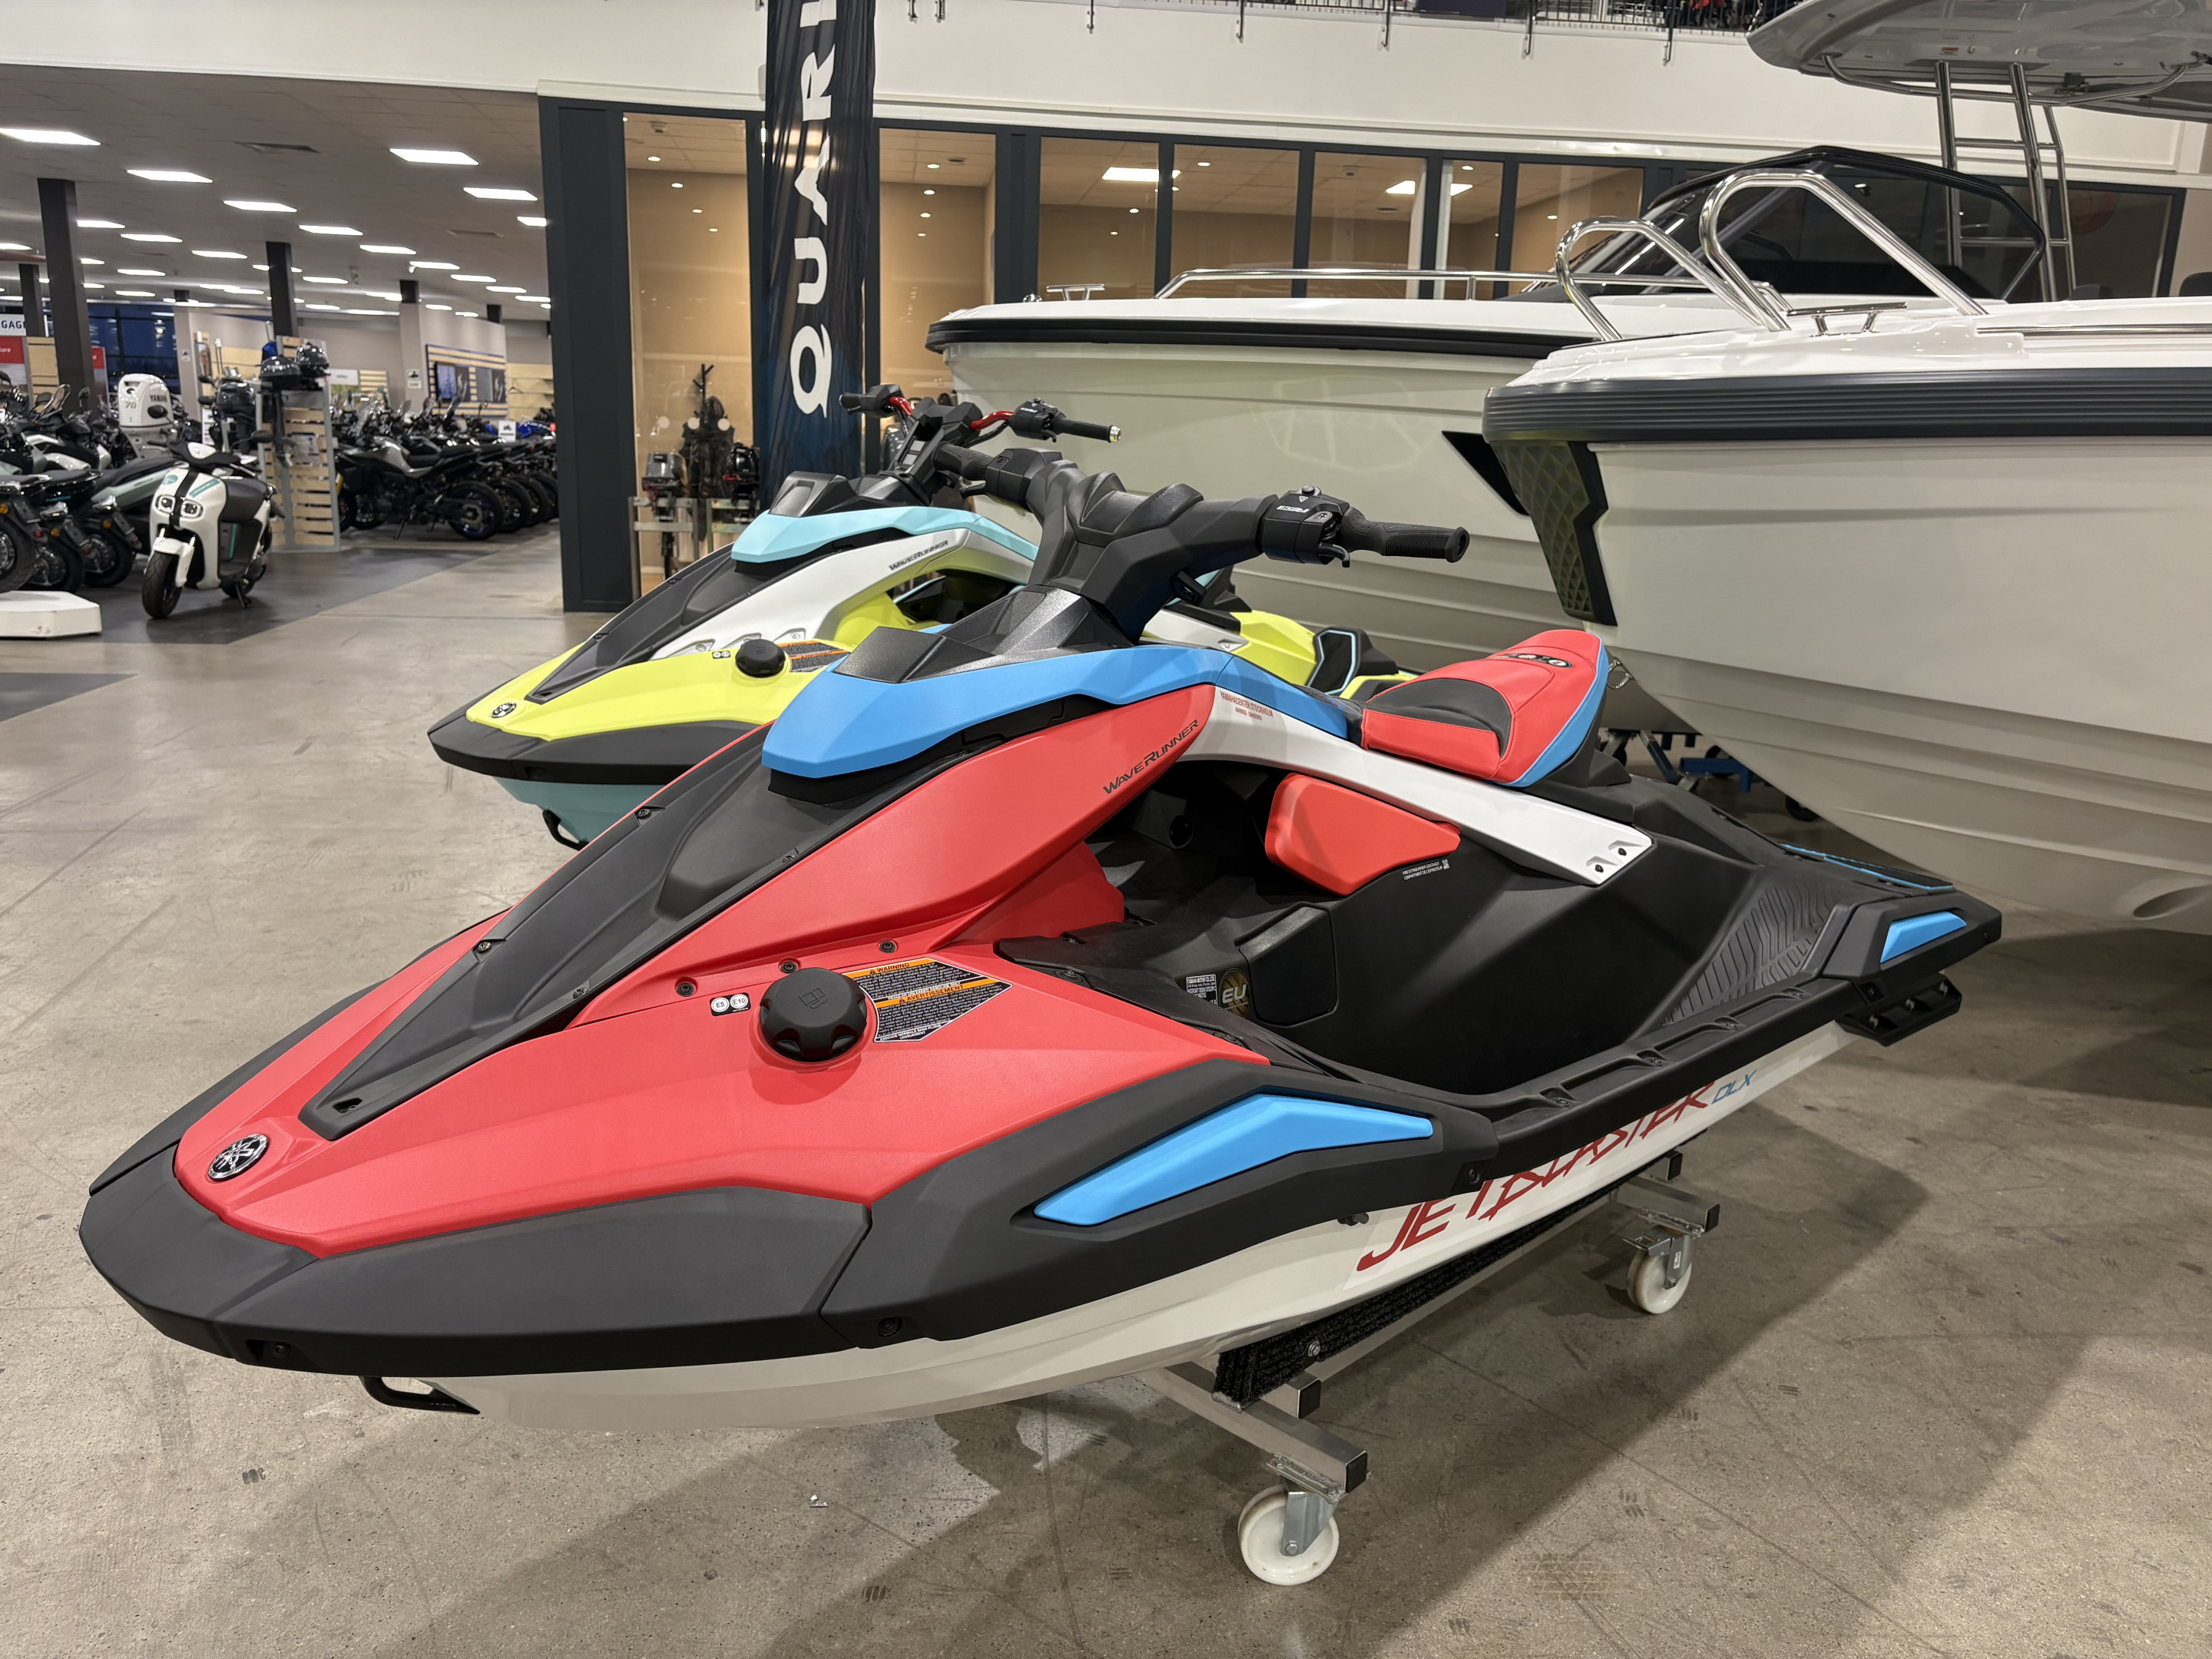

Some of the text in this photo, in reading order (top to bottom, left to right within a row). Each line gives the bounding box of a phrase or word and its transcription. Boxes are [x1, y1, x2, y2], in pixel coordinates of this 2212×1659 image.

[876, 962, 910, 972] WARNING
[907, 985, 965, 1002] AVERTISSEMENT
[1222, 984, 1247, 1004] EU
[1711, 1069, 1757, 1104] DLX
